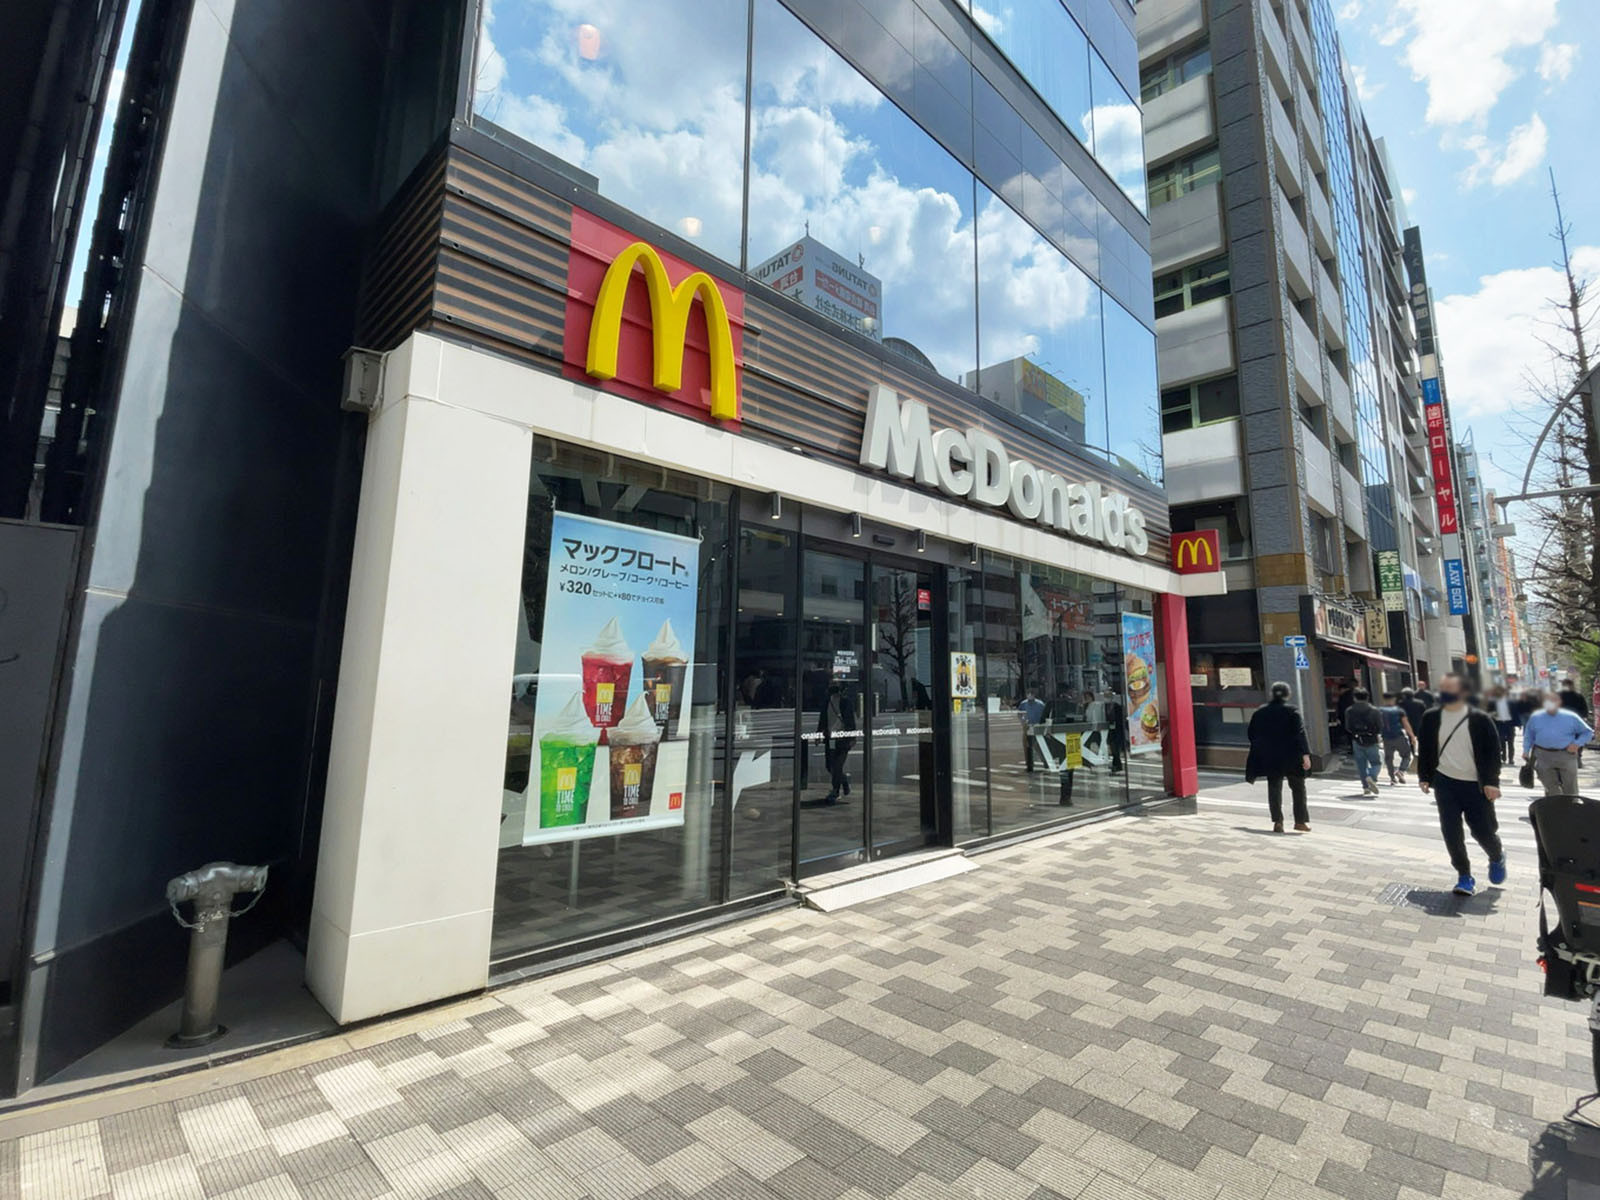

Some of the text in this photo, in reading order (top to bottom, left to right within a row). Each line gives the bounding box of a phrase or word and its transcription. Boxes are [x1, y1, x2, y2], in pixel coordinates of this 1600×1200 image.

[860, 383, 1149, 556] McDonald's
[1432, 436, 1454, 527] ローヤル
[562, 538, 686, 575] マックフロート
[557, 789, 575, 804] TIME
[624, 784, 640, 798] TIME
